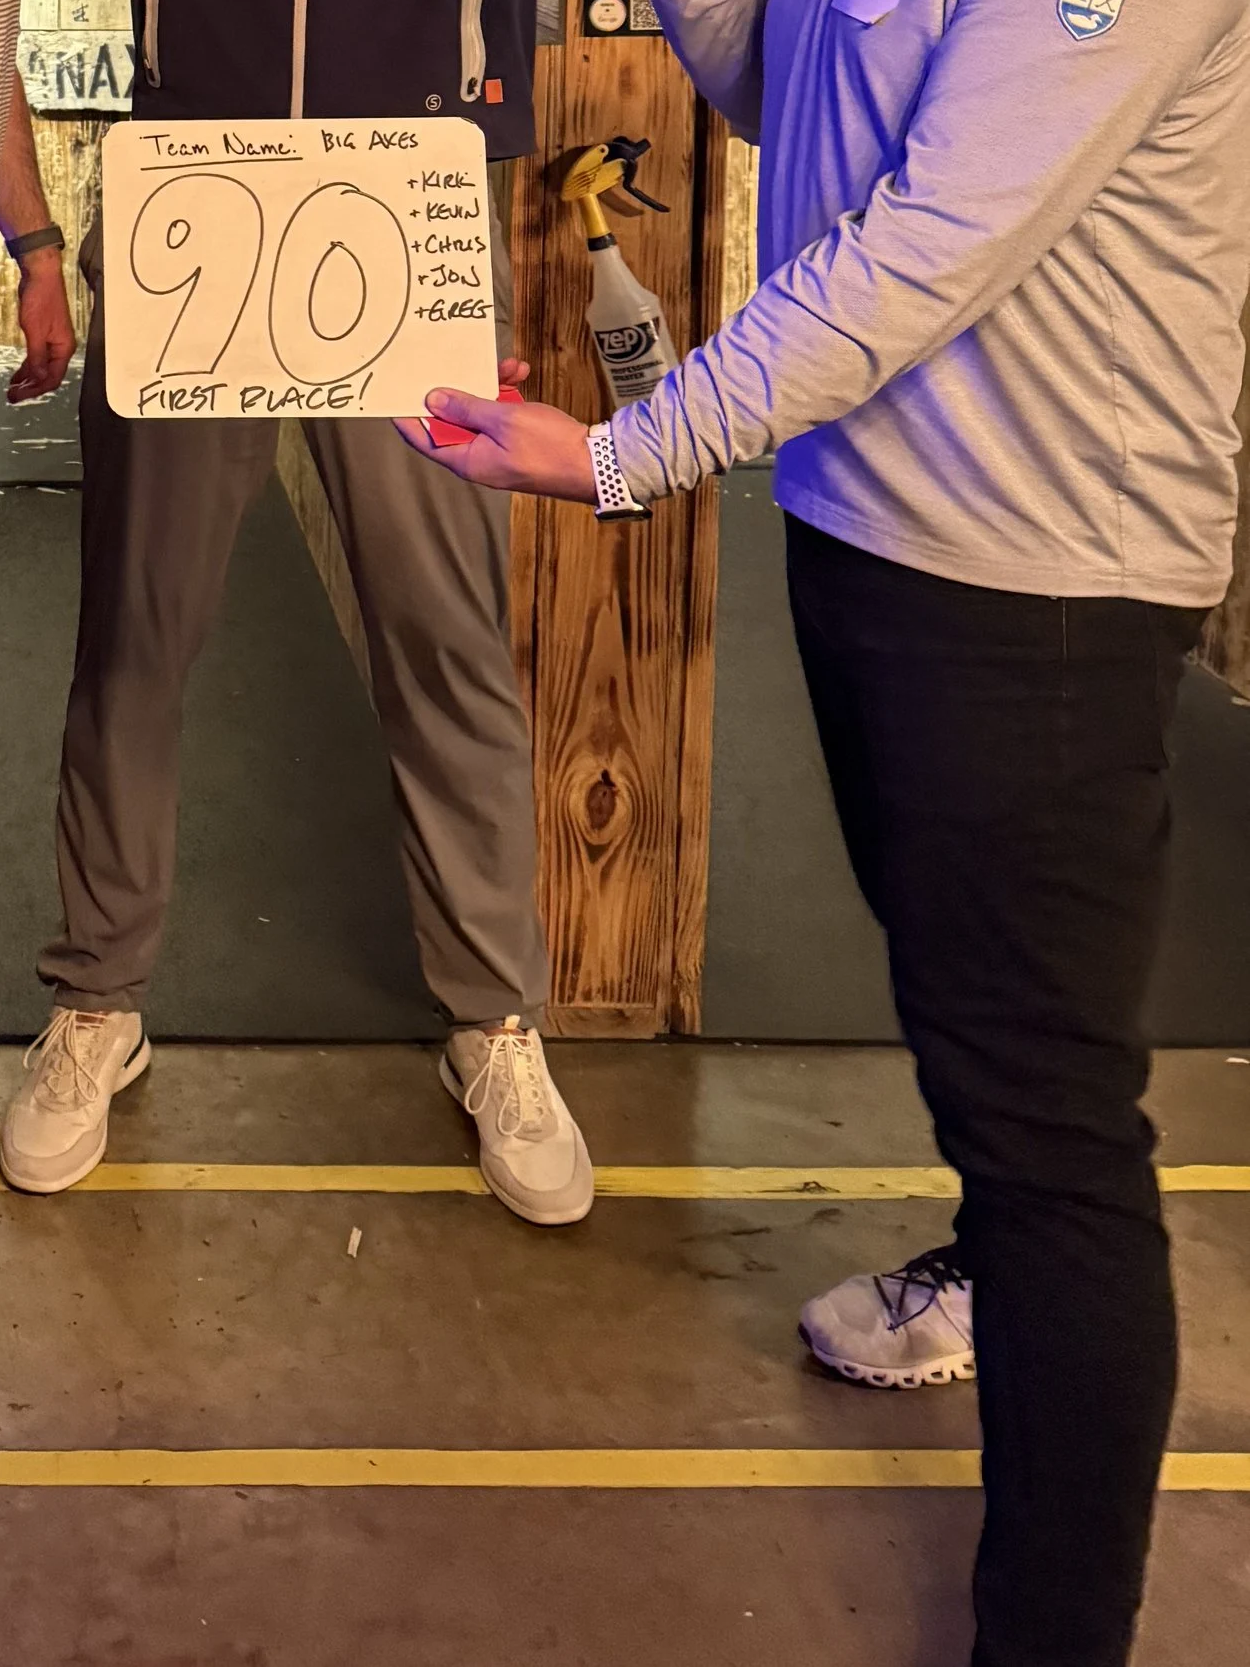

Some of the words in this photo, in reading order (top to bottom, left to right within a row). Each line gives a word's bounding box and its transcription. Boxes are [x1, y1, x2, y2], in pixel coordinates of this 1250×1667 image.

[140, 134, 210, 156] Team
[223, 132, 297, 156] Name:
[321, 129, 356, 152] BIG
[130, 172, 412, 387] 90
[137, 380, 228, 415] FIRST
[239, 372, 373, 413] PLACE!
